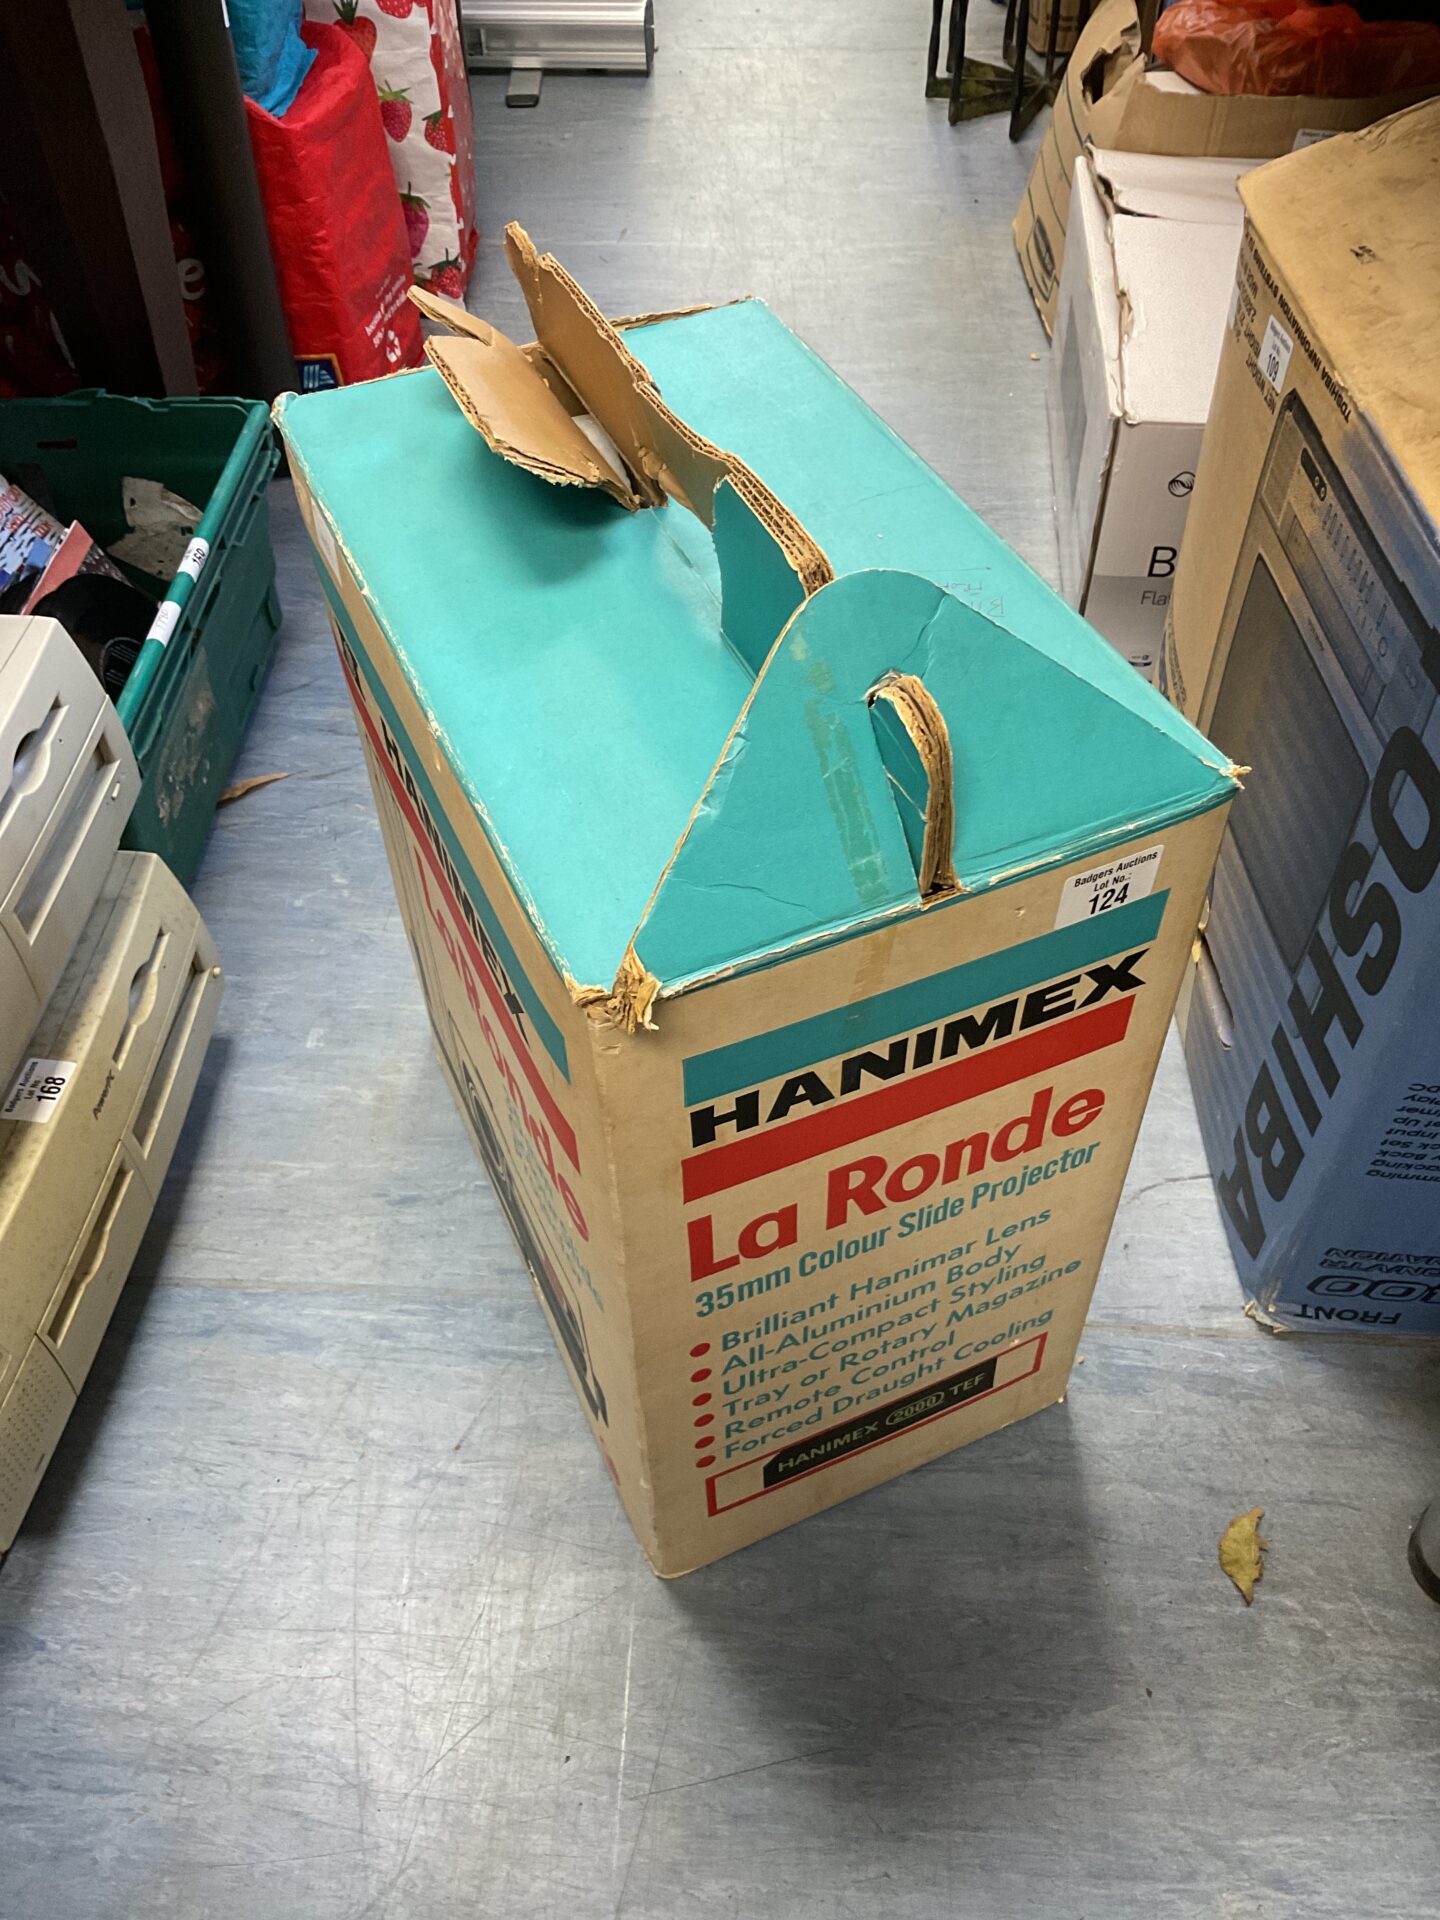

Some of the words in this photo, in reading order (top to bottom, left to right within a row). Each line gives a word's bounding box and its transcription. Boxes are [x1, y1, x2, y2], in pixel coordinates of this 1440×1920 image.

[1253, 248, 1279, 299] SYSTEMS
[1277, 293, 1322, 372] INFORMATION
[1266, 353, 1280, 383] 109
[1320, 366, 1352, 424] TOSHIBA
[1074, 868, 1114, 888] Badgers
[1116, 851, 1158, 873] Auctions
[1089, 882, 1130, 915] 124
[1094, 880, 1109, 892] Lot
[689, 948, 1150, 1148] HANIMEX
[36, 1076, 66, 1102] 168
[1393, 1117, 1421, 1127] Up
[1376, 1150, 1428, 1160] Back
[1385, 1128, 1440, 1139] Input
[687, 1203, 798, 1282] La
[826, 1086, 1106, 1231] Ronde
[695, 1265, 791, 1318] 35mm
[799, 1226, 893, 1277] Colour
[897, 1197, 965, 1239] Slide
[971, 1141, 1101, 1209] Projector
[721, 1280, 936, 1376] All-Aluminium
[946, 1244, 1022, 1284] Body
[722, 1293, 840, 1351] Brilliant
[850, 1240, 978, 1300] Hanimar
[985, 1209, 1051, 1246] Lens
[722, 1384, 790, 1417] Tray
[800, 1367, 831, 1387] or
[840, 1323, 938, 1372] Rotary
[945, 1260, 1081, 1327] Magazine
[723, 1298, 941, 1395] Ultra-Compact
[949, 1255, 1046, 1305] Styling
[1294, 1304, 1402, 1325] FRONT
[725, 1385, 841, 1439] Remote
[851, 1330, 955, 1385] Control
[725, 1406, 823, 1459] Forced
[833, 1358, 945, 1414] Draught
[954, 1310, 1054, 1361] Cooling
[777, 1421, 879, 1473] HANIMEX
[890, 1395, 938, 1422] 2000
[949, 1371, 986, 1396] TEF
